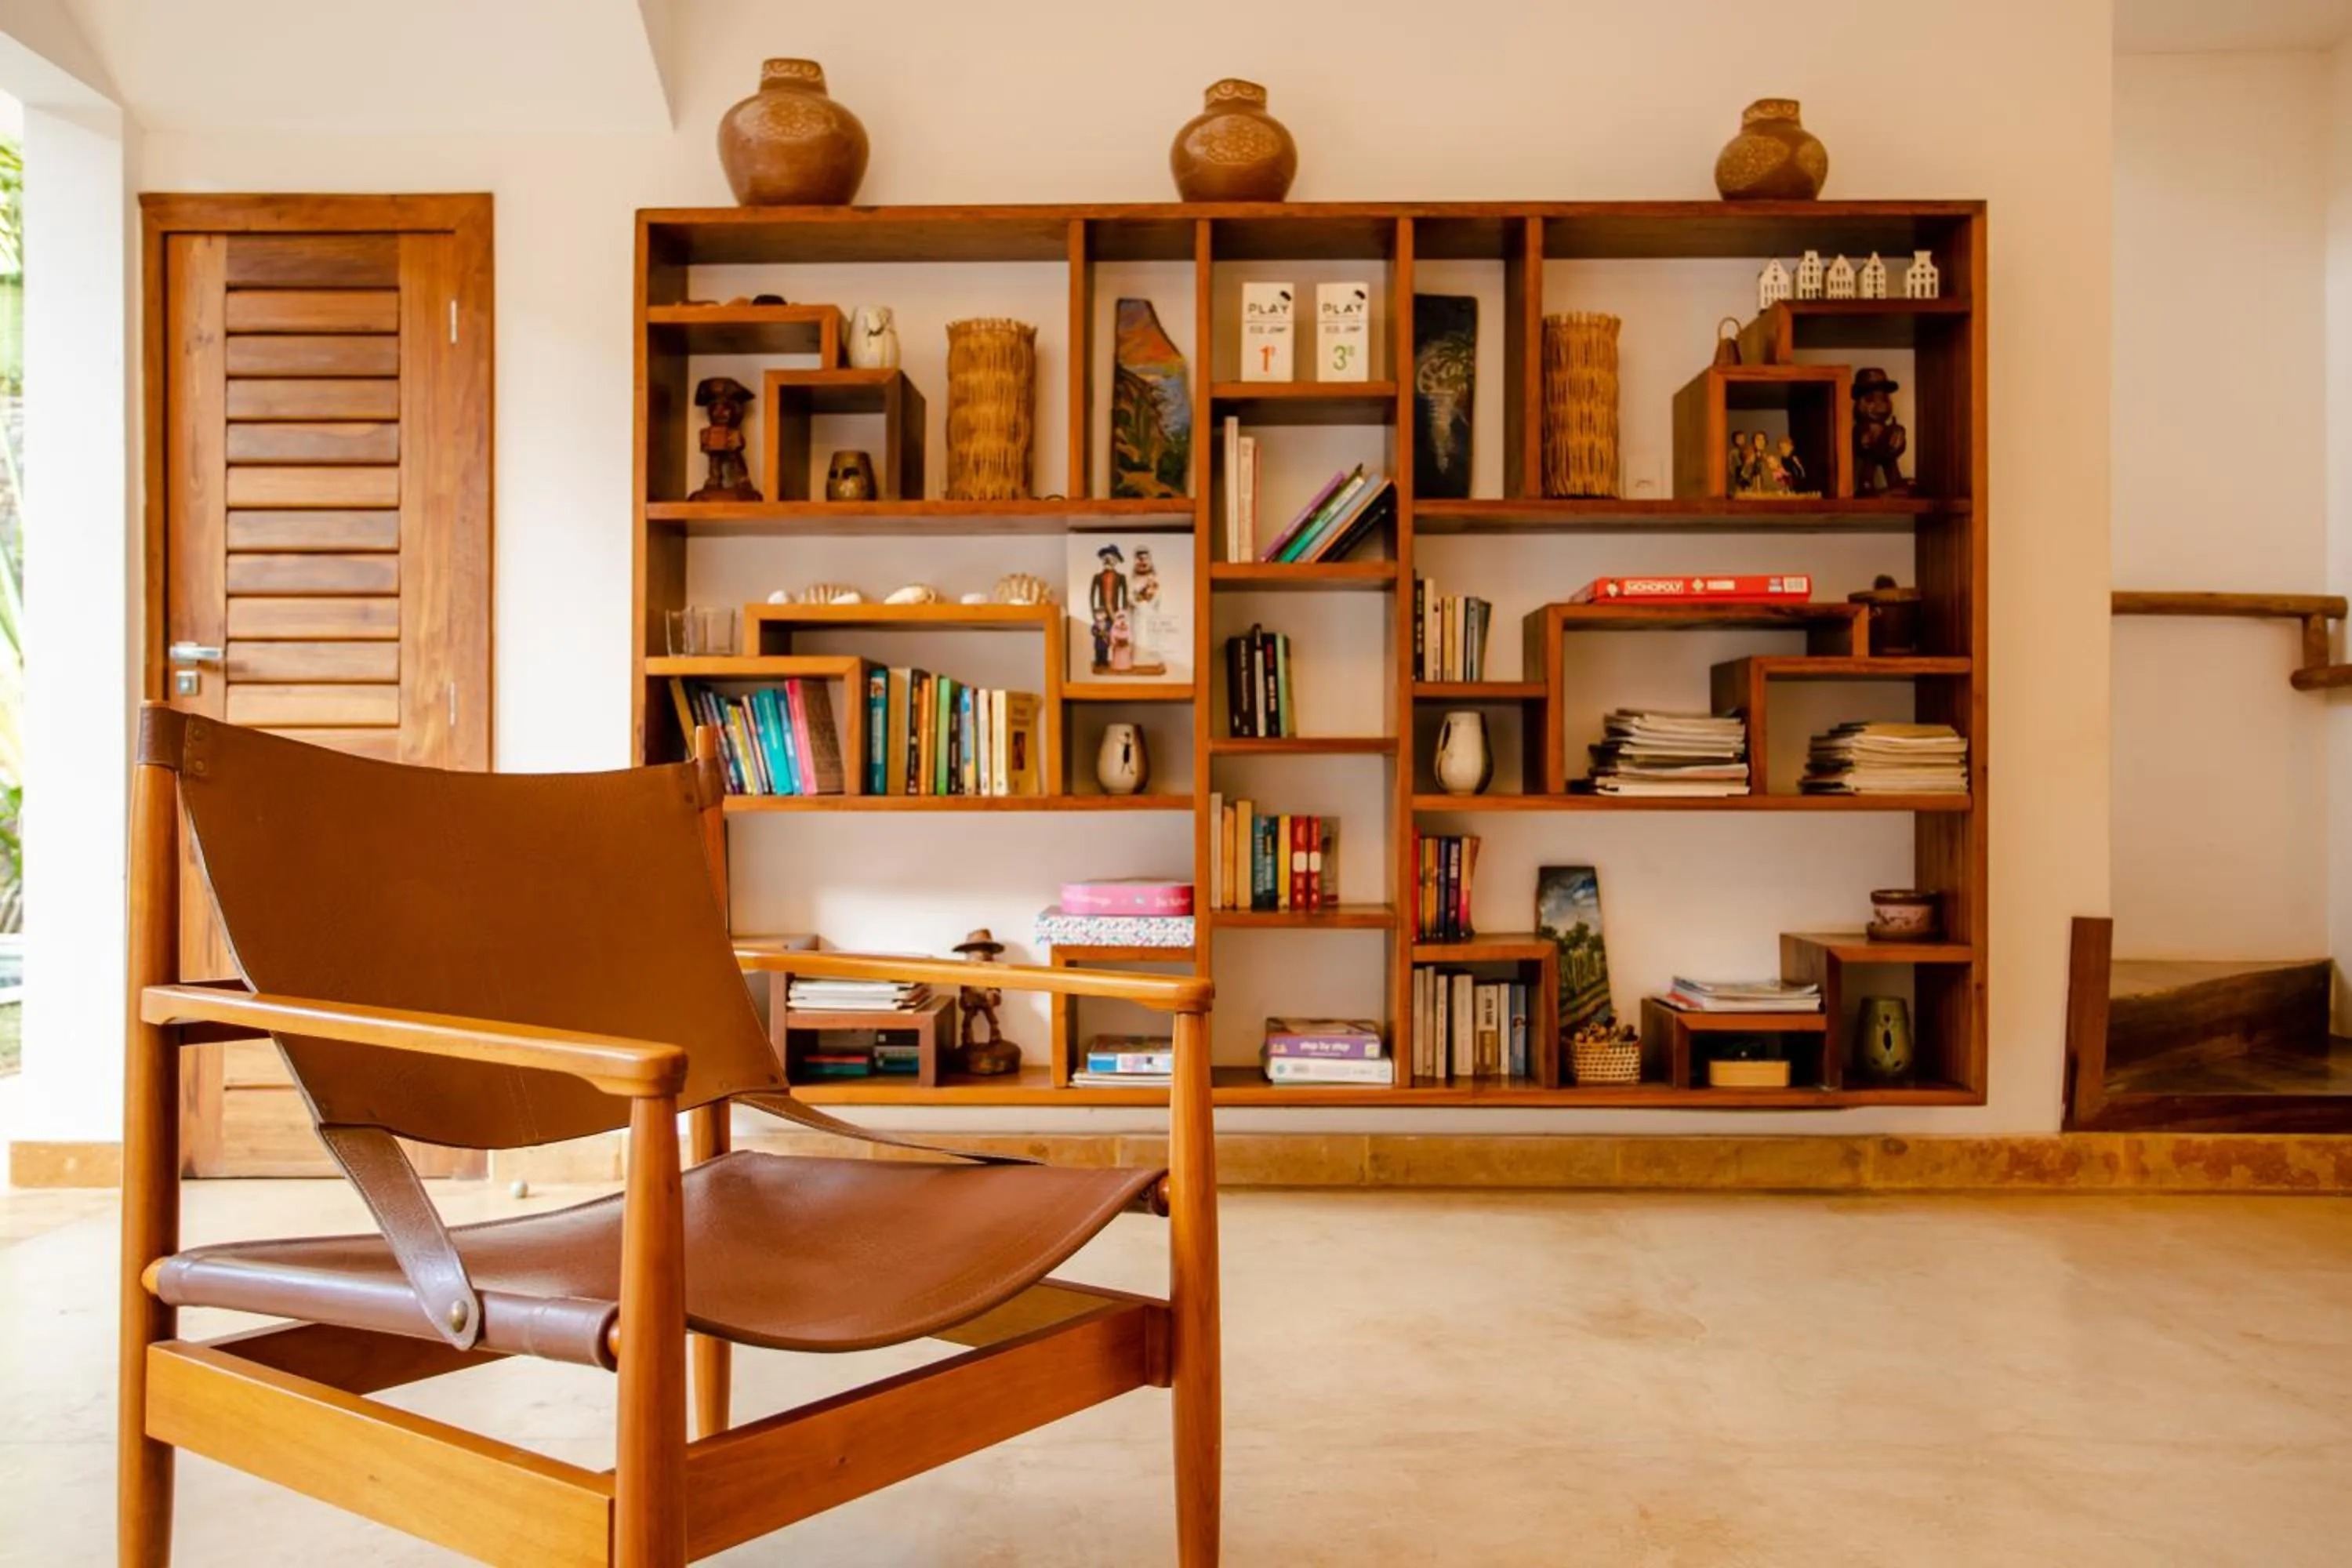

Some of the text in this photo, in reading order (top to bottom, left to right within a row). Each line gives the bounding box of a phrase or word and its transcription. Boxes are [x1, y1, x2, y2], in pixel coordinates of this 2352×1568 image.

[1247, 303, 1289, 314] PLAY
[1322, 303, 1363, 314] PLAY
[1626, 581, 1682, 593] MONOPOLY
